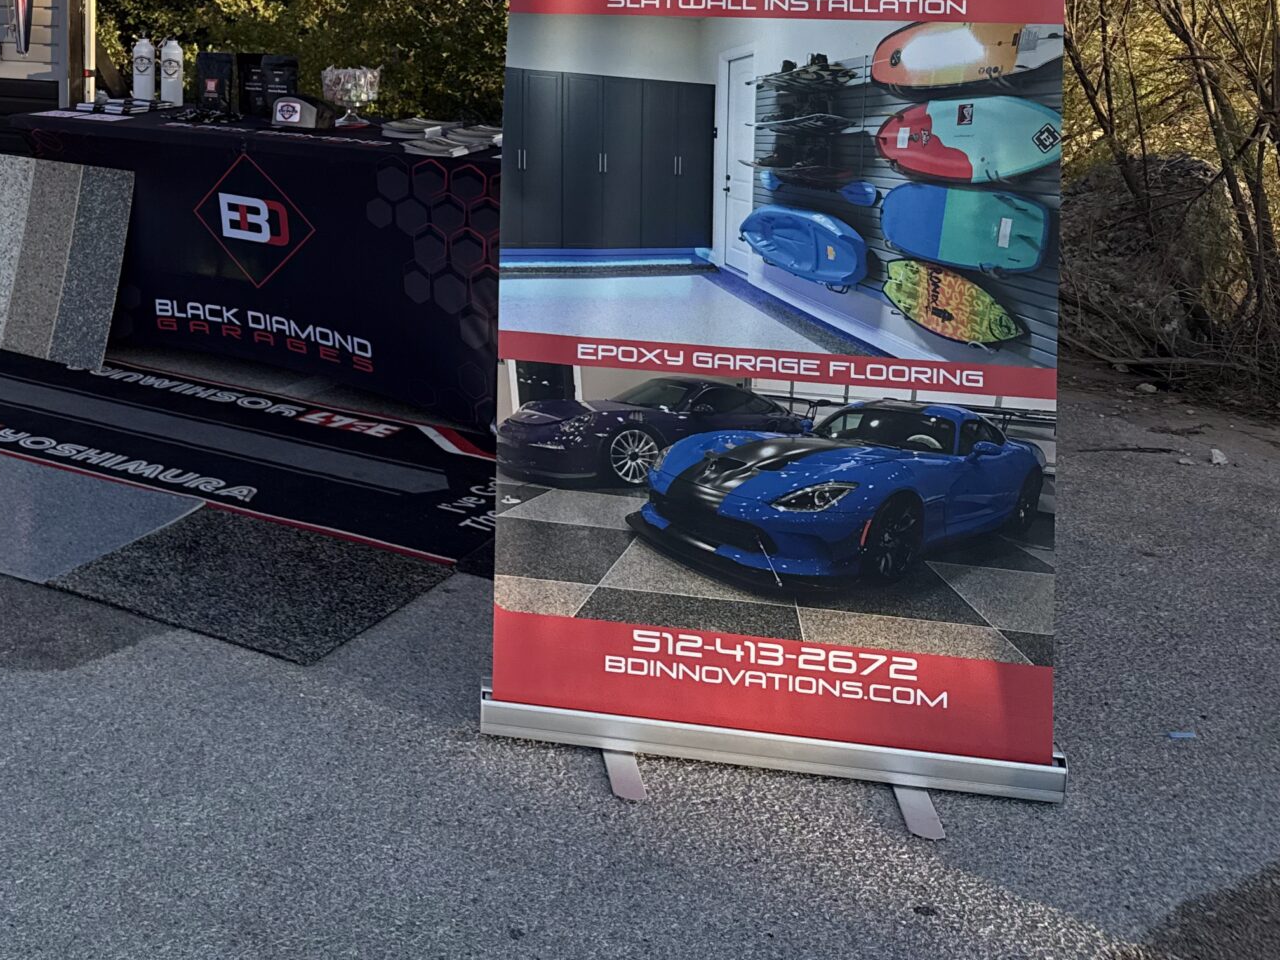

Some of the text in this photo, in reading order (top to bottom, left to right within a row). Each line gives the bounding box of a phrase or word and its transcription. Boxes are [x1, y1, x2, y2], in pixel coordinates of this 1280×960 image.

[155, 299, 372, 358] BLACK DIAMOND
[157, 317, 374, 373] GARAGES
[577, 343, 984, 388] EPOXY GARAGE FLOORING
[436, 496, 486, 514] I've
[605, 654, 949, 709] BDINNOVATIONS.COM
[632, 628, 919, 682] 512-413-2672
